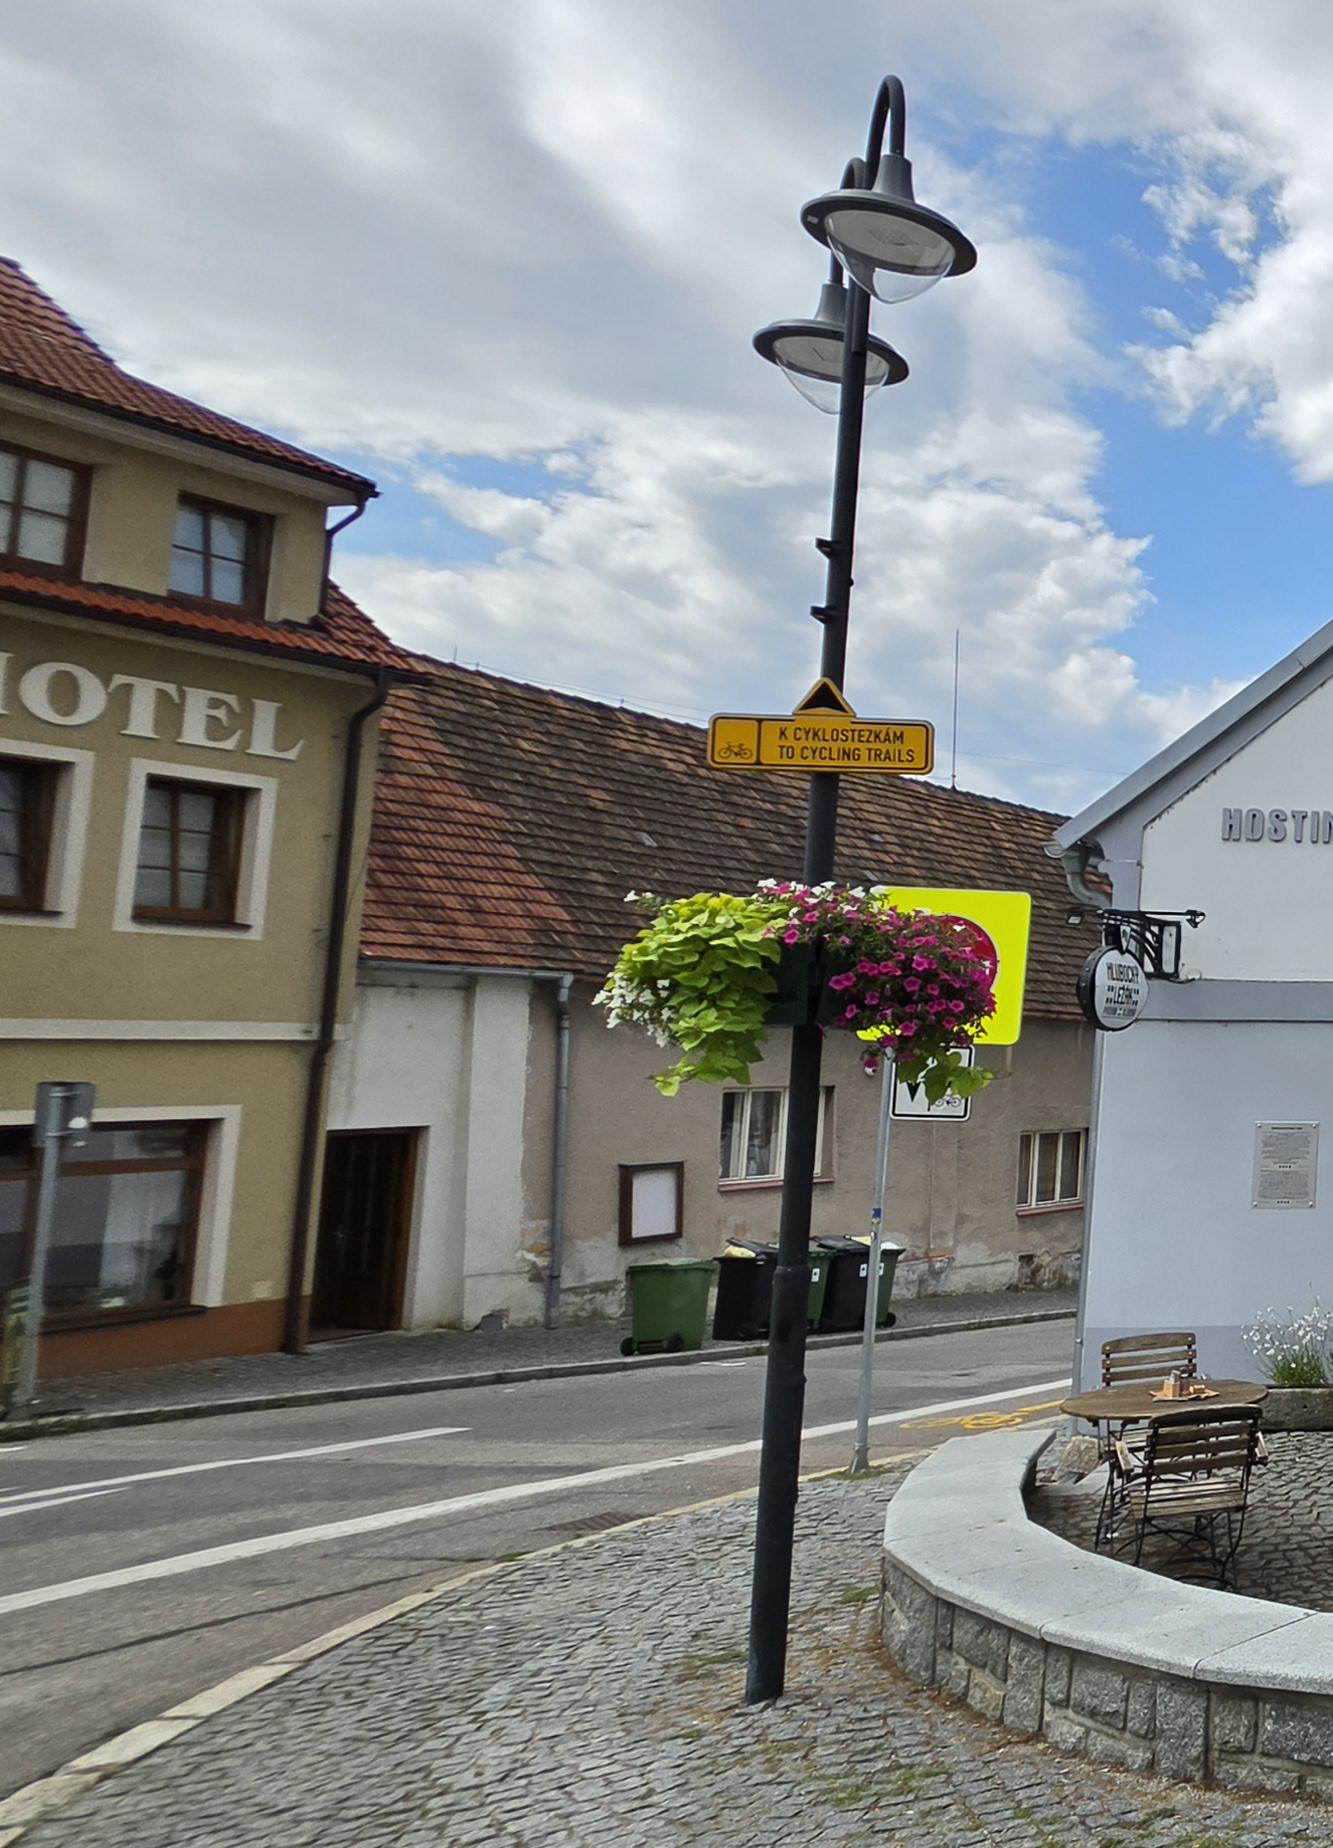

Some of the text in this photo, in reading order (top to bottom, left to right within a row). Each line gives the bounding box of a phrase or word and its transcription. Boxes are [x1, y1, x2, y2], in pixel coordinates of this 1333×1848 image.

[0, 652, 304, 761] OTEL
[779, 726, 904, 744] K CYKLOSTEZKÁM
[778, 745, 915, 763] TO CYCLING TRAILS
